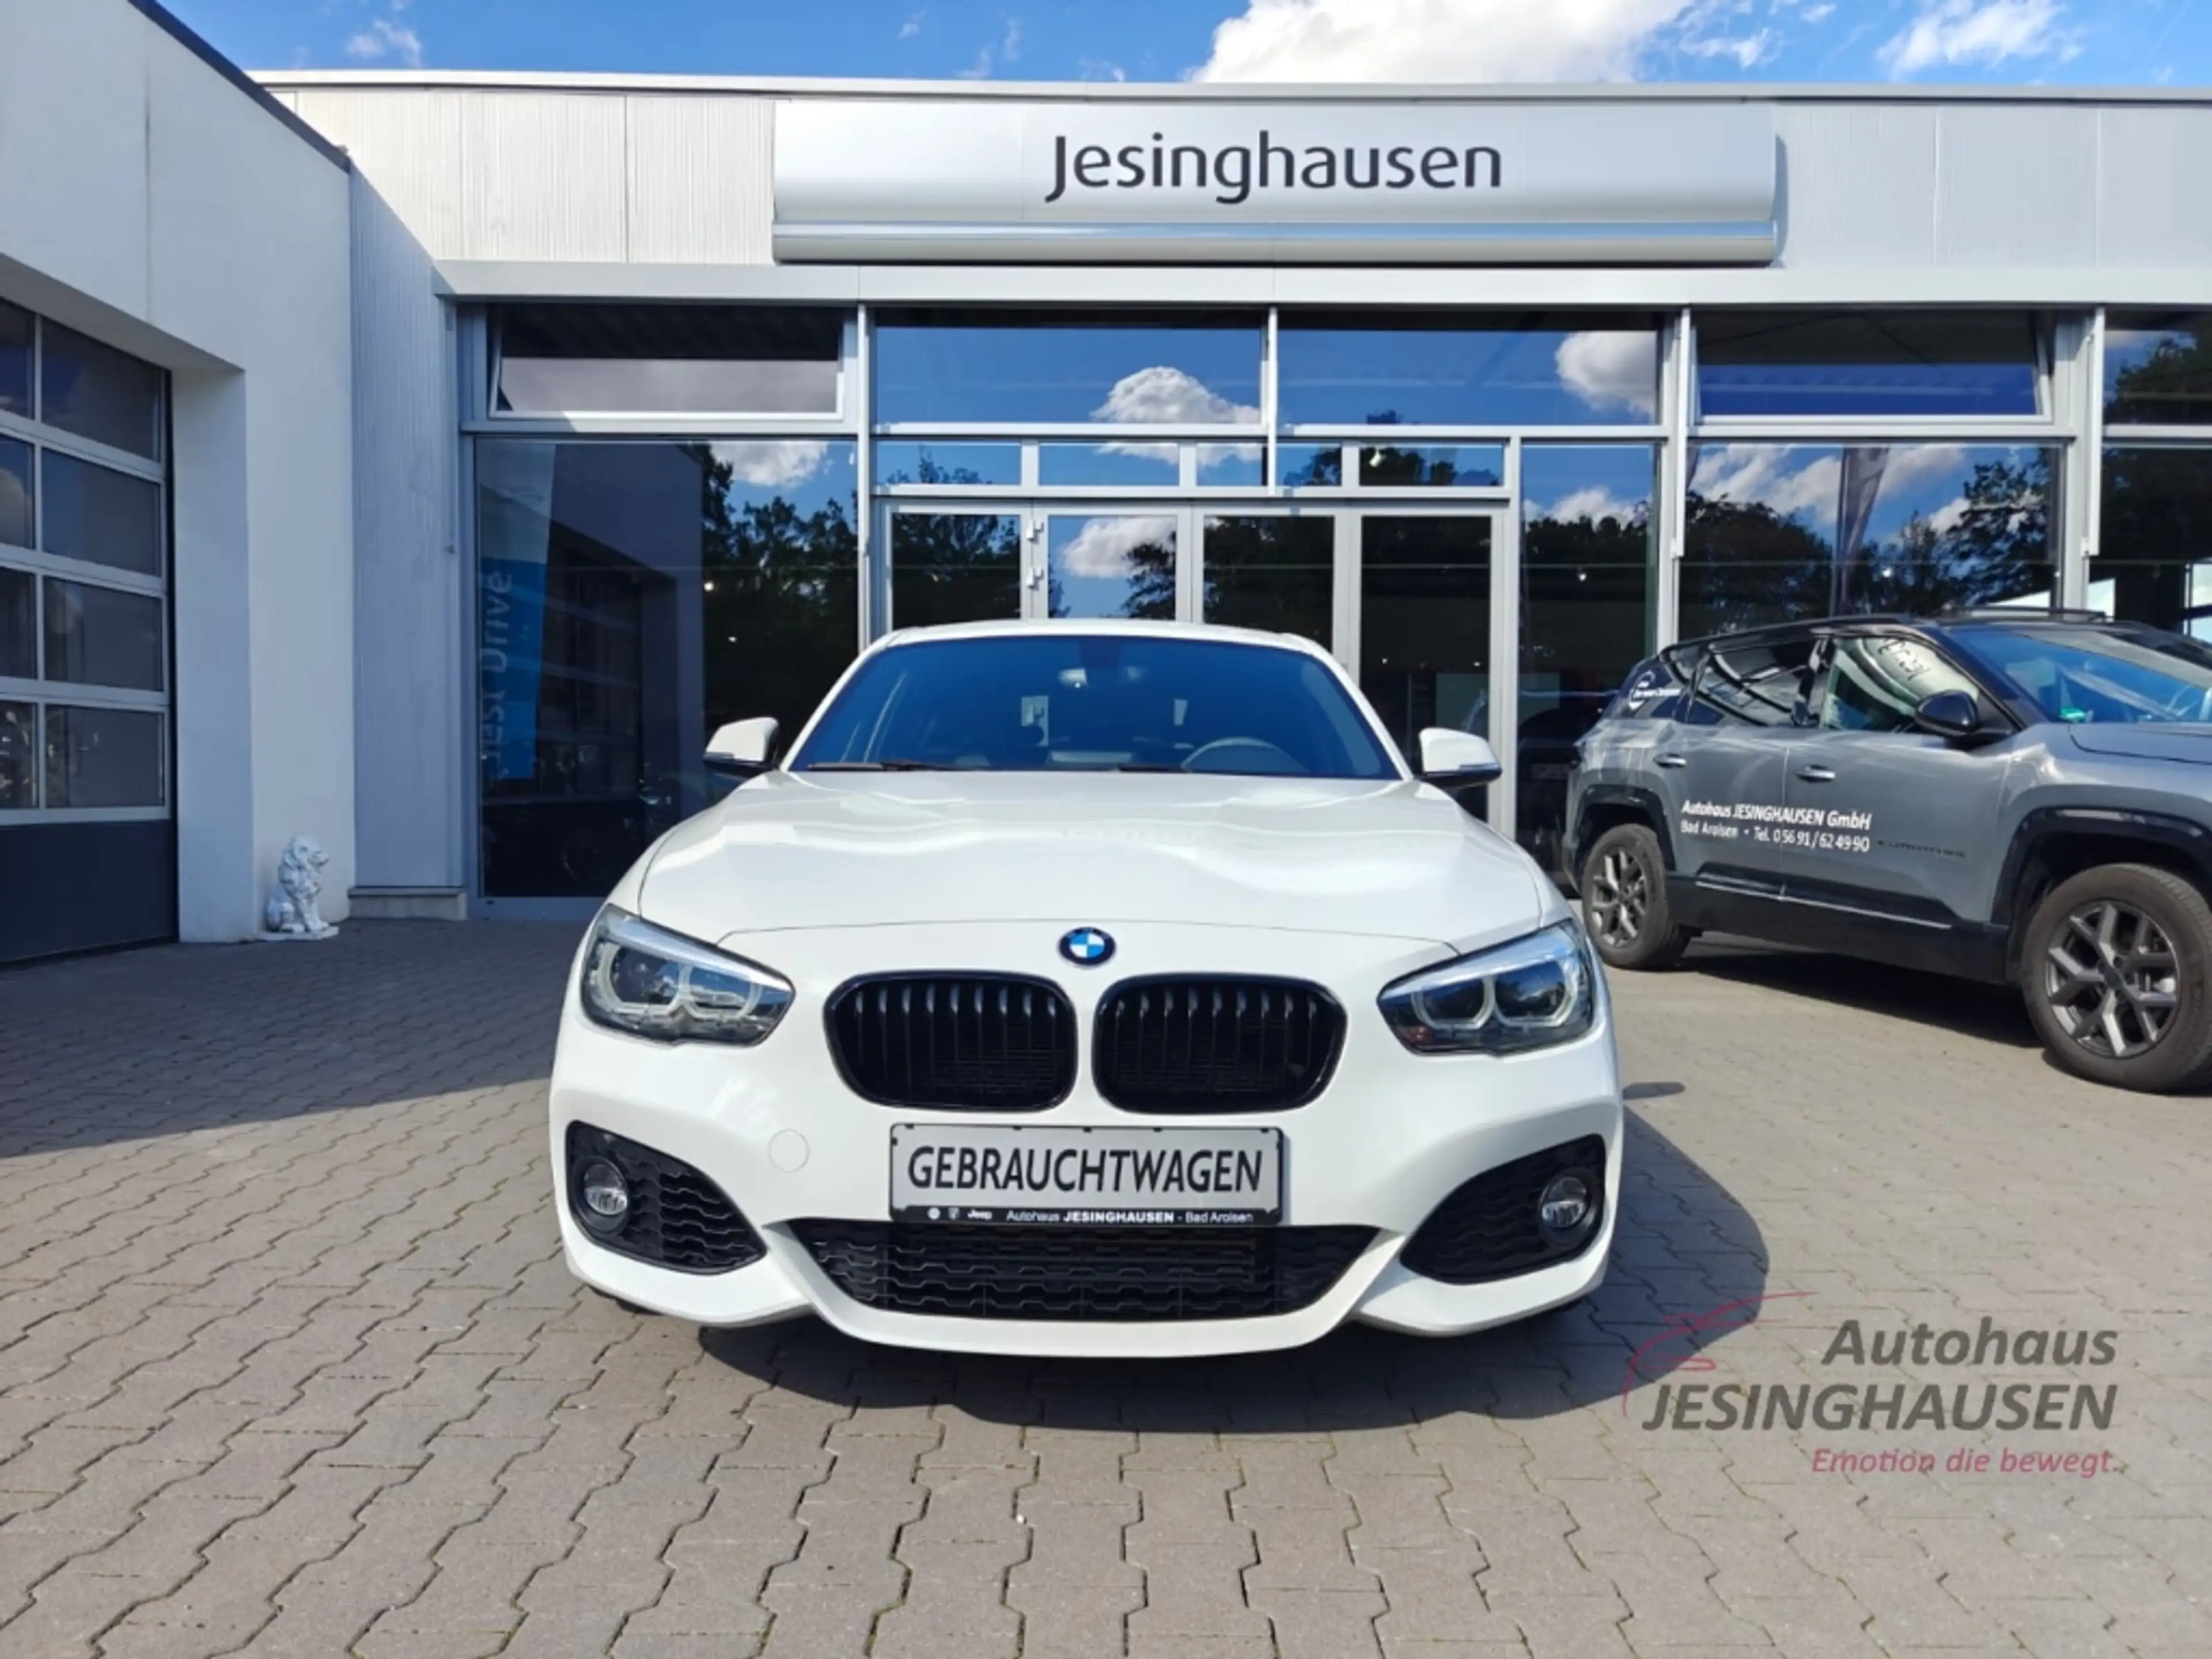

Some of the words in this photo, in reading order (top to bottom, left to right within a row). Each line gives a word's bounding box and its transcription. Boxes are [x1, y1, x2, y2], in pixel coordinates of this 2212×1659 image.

[1044, 130, 1501, 205] Jesinghausen
[1680, 818, 1699, 835] Bad
[1681, 799, 1732, 817] Autohaus
[1732, 803, 1825, 827] JESINGHAUSEN
[1827, 810, 1872, 831] GmbH
[908, 1145, 1263, 1194] GEBRAUCHTWAGEN
[1006, 1209, 1060, 1222] Autohaus
[1063, 1210, 1175, 1224] JESINGHAUSEN
[1185, 1211, 1209, 1224] Bad
